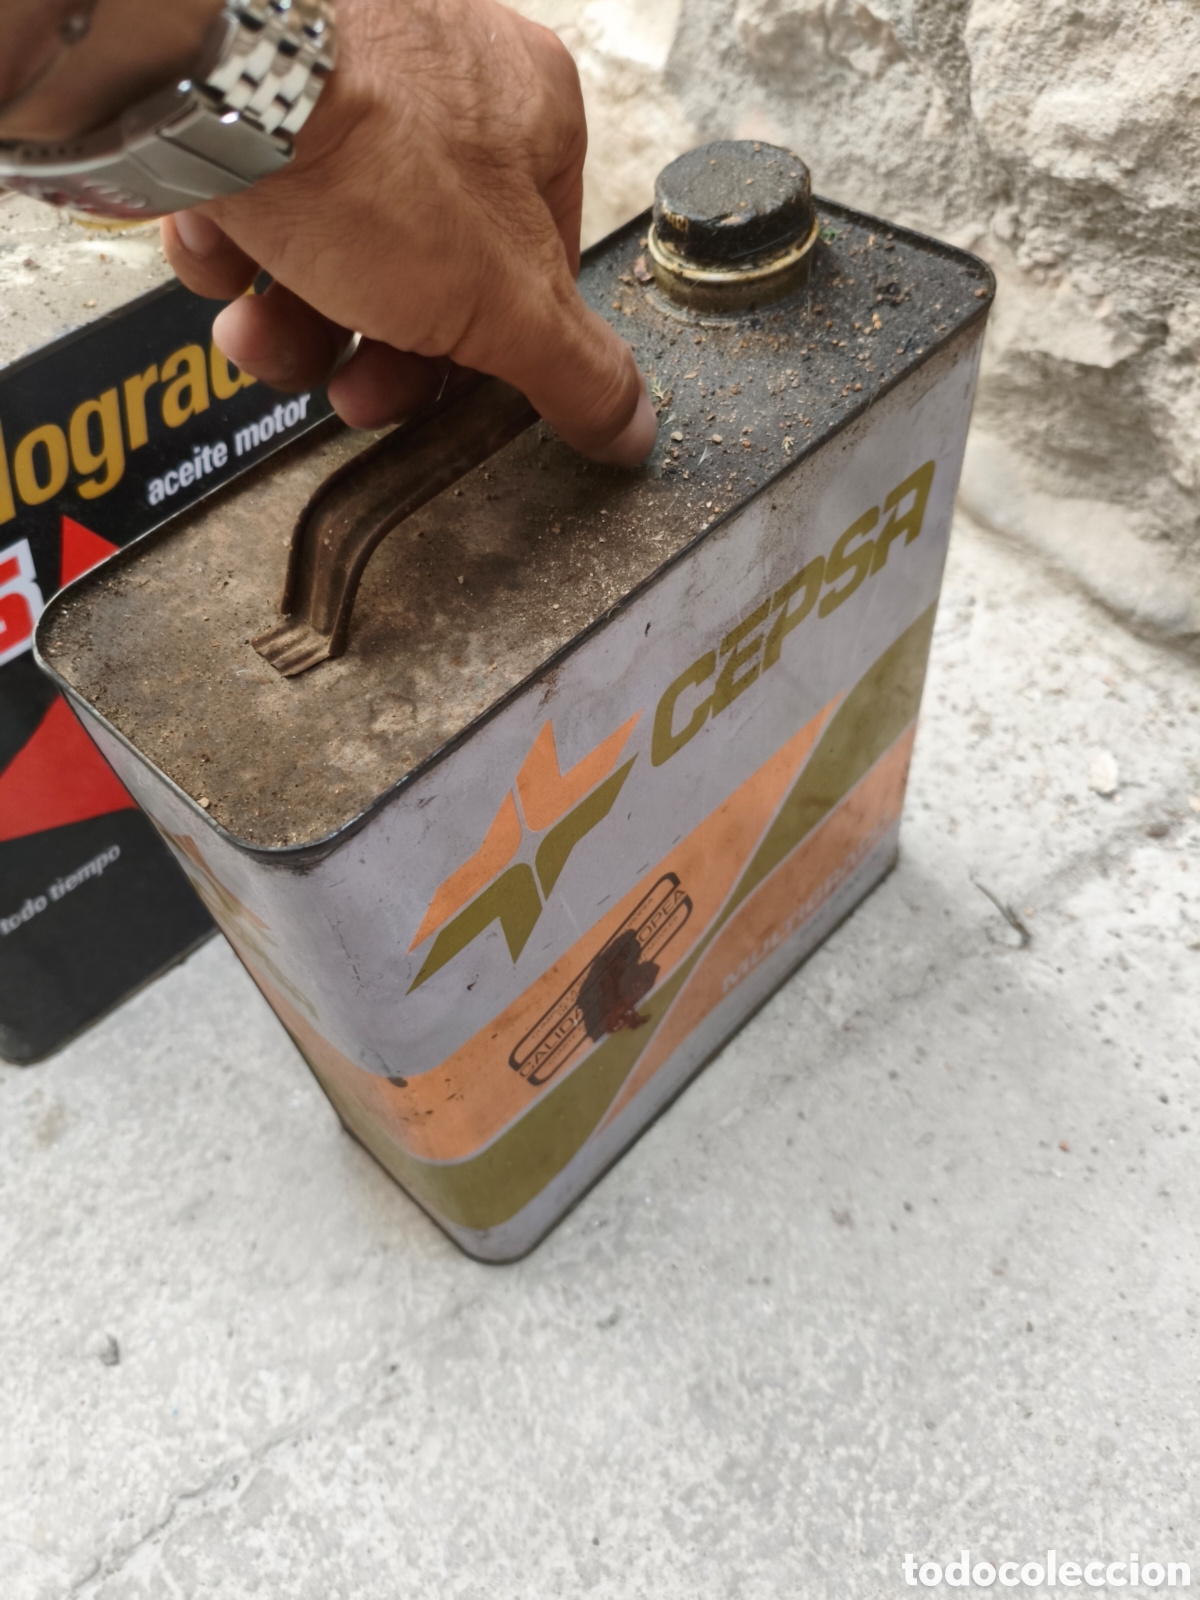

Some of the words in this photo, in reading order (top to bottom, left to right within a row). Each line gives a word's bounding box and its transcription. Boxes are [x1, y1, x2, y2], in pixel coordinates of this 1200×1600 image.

[147, 442, 228, 506] aceite
[234, 394, 311, 457] motor
[651, 460, 935, 767] CEPSA
[0, 895, 47, 936] todo
[48, 844, 121, 902] tiempo
[519, 1006, 583, 1078] CALIDA
[637, 889, 687, 943] OPEA
